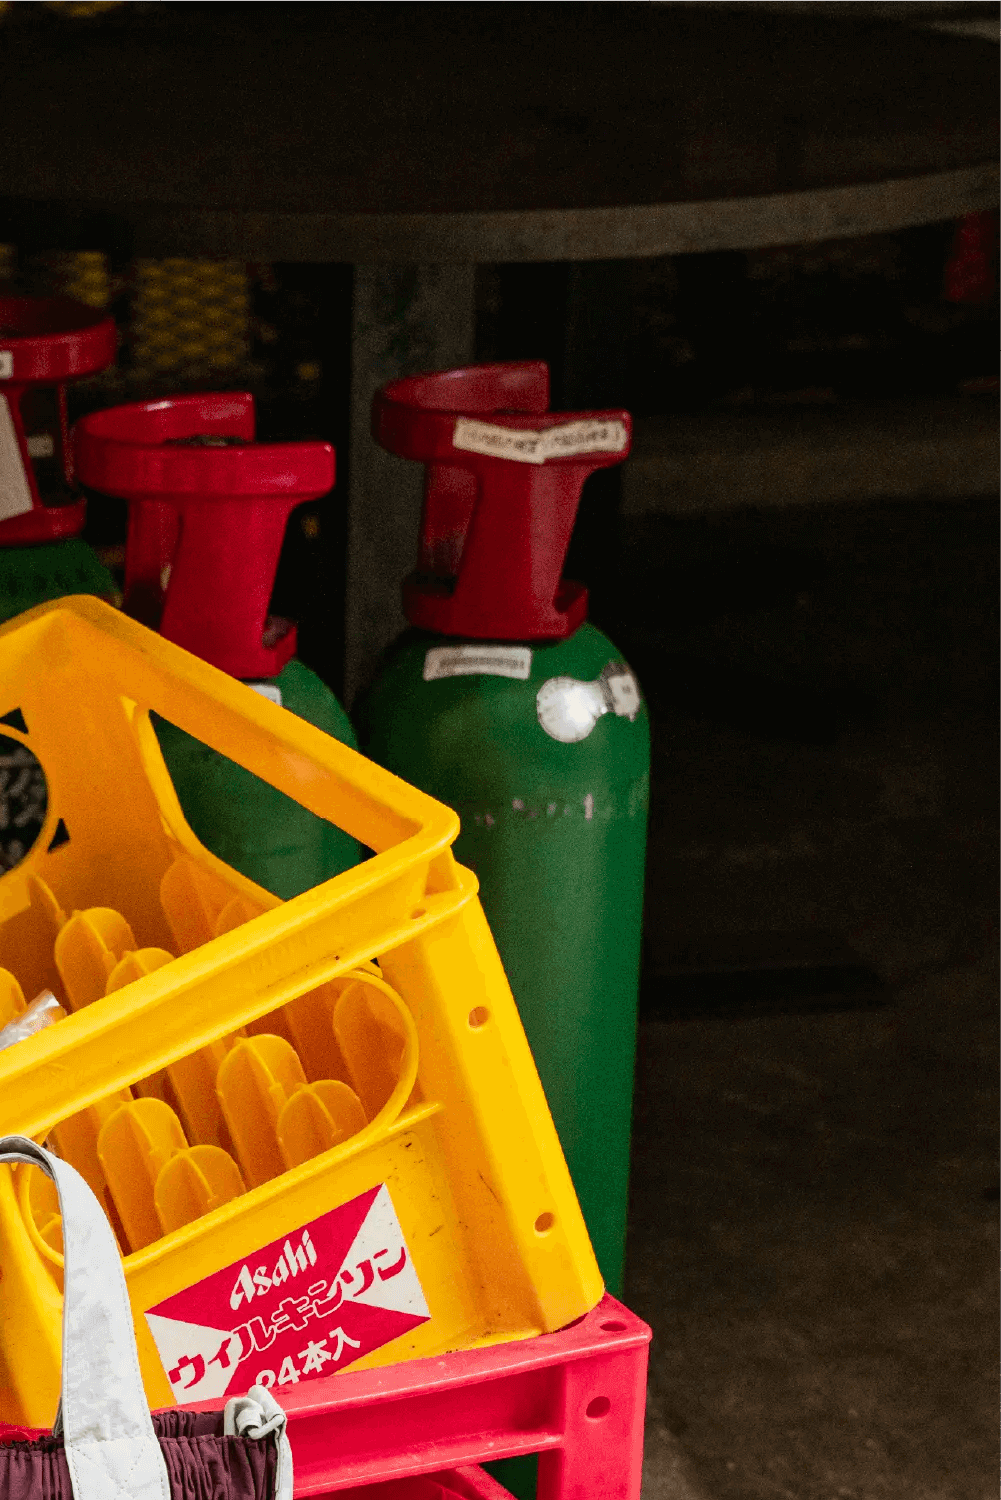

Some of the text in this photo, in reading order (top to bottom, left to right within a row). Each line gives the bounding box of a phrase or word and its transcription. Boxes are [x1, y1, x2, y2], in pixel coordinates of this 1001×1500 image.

[168, 1246, 407, 1390] ウィルキンソン
[229, 1229, 318, 1311] Asahi
